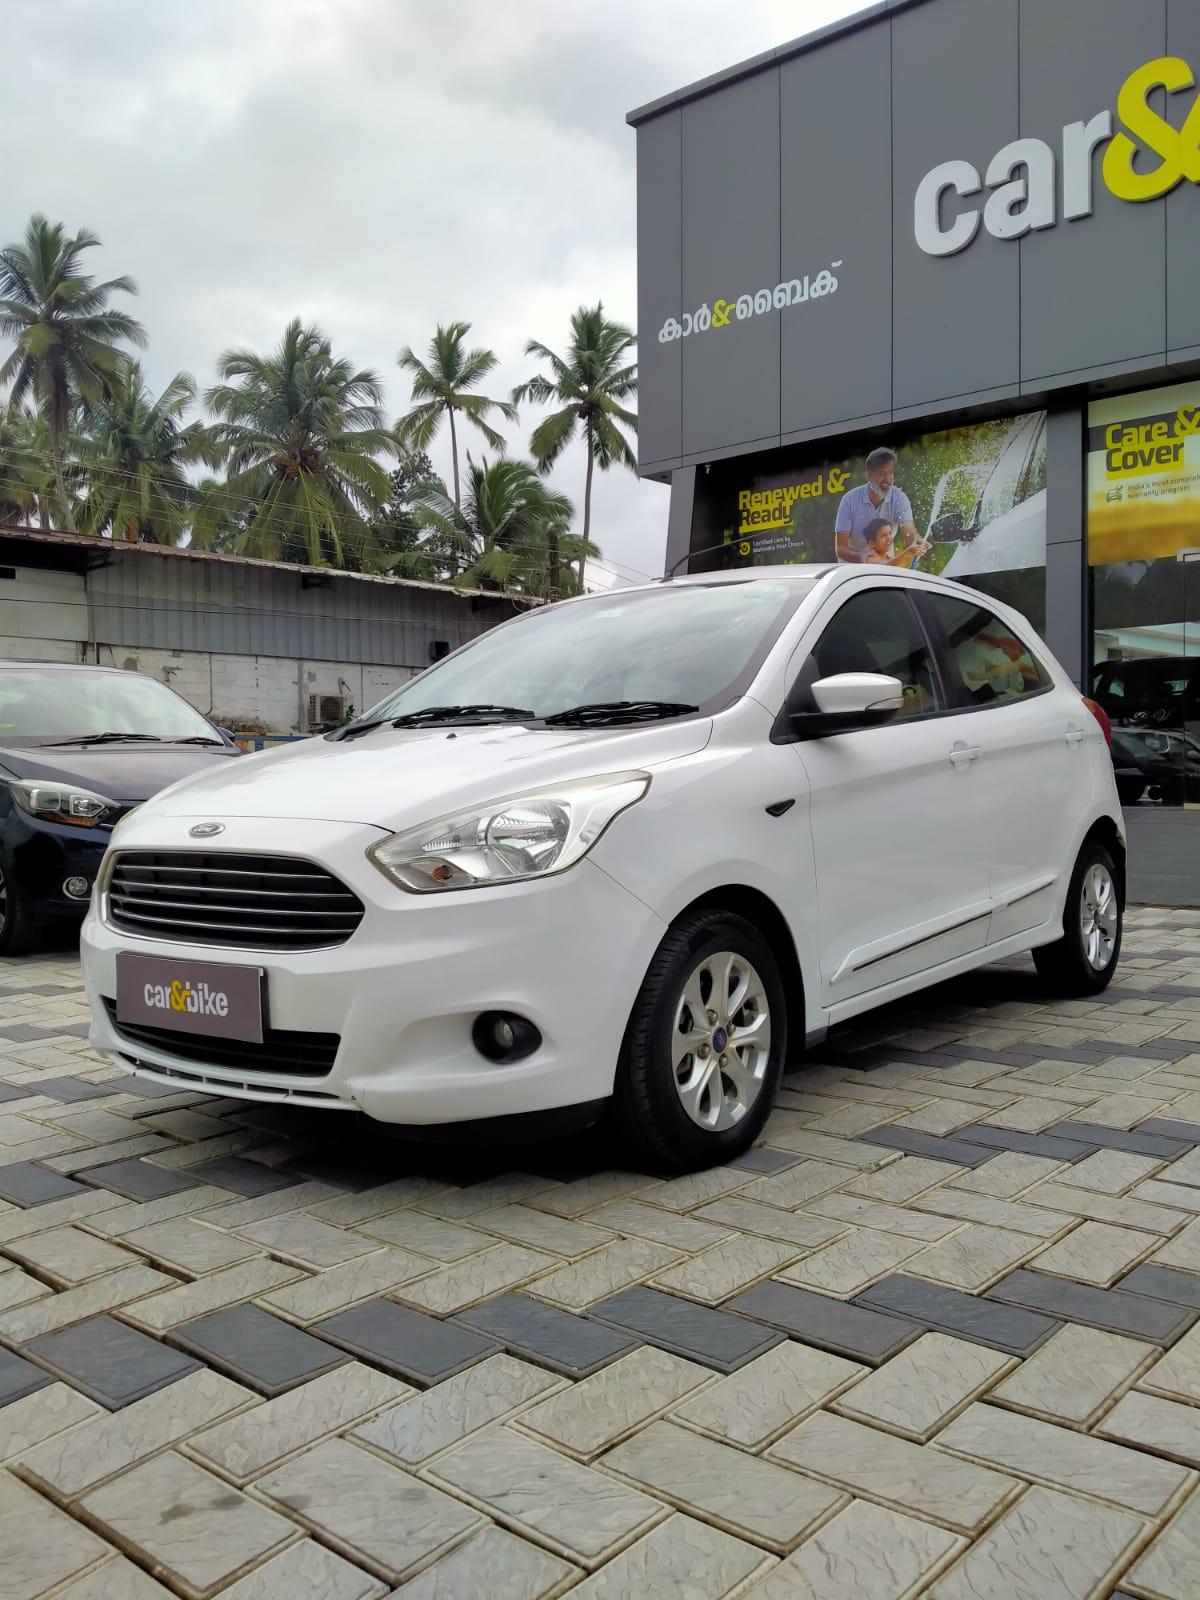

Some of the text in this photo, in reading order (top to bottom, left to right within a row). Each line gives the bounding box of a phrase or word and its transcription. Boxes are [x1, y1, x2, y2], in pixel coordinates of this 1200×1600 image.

[1105, 403, 1200, 450] Care &
[1105, 443, 1184, 472] Cover
[739, 468, 852, 509] Renewed &
[1160, 485, 1190, 497] program
[740, 500, 793, 526] Ready
[143, 979, 229, 1017] car&bike
